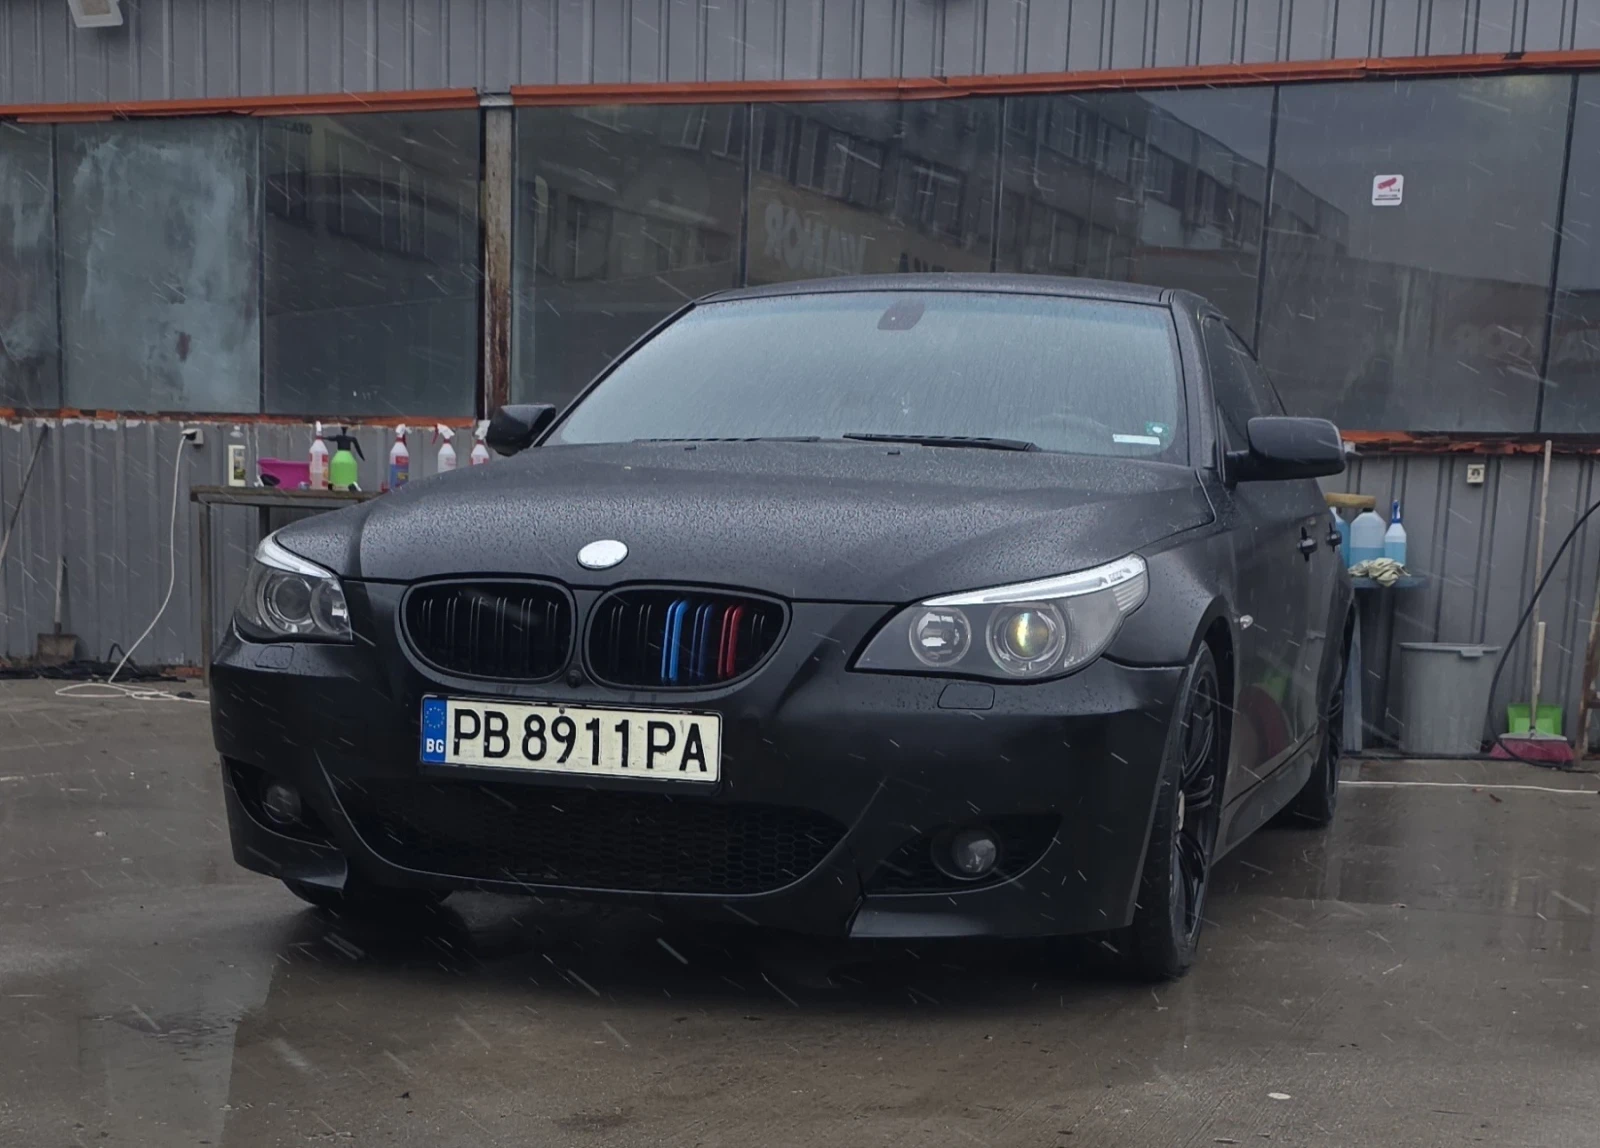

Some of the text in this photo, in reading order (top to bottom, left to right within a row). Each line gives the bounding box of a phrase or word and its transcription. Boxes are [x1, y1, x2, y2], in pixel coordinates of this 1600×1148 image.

[426, 739, 444, 753] BG
[453, 708, 708, 772] PB 8911 PA
